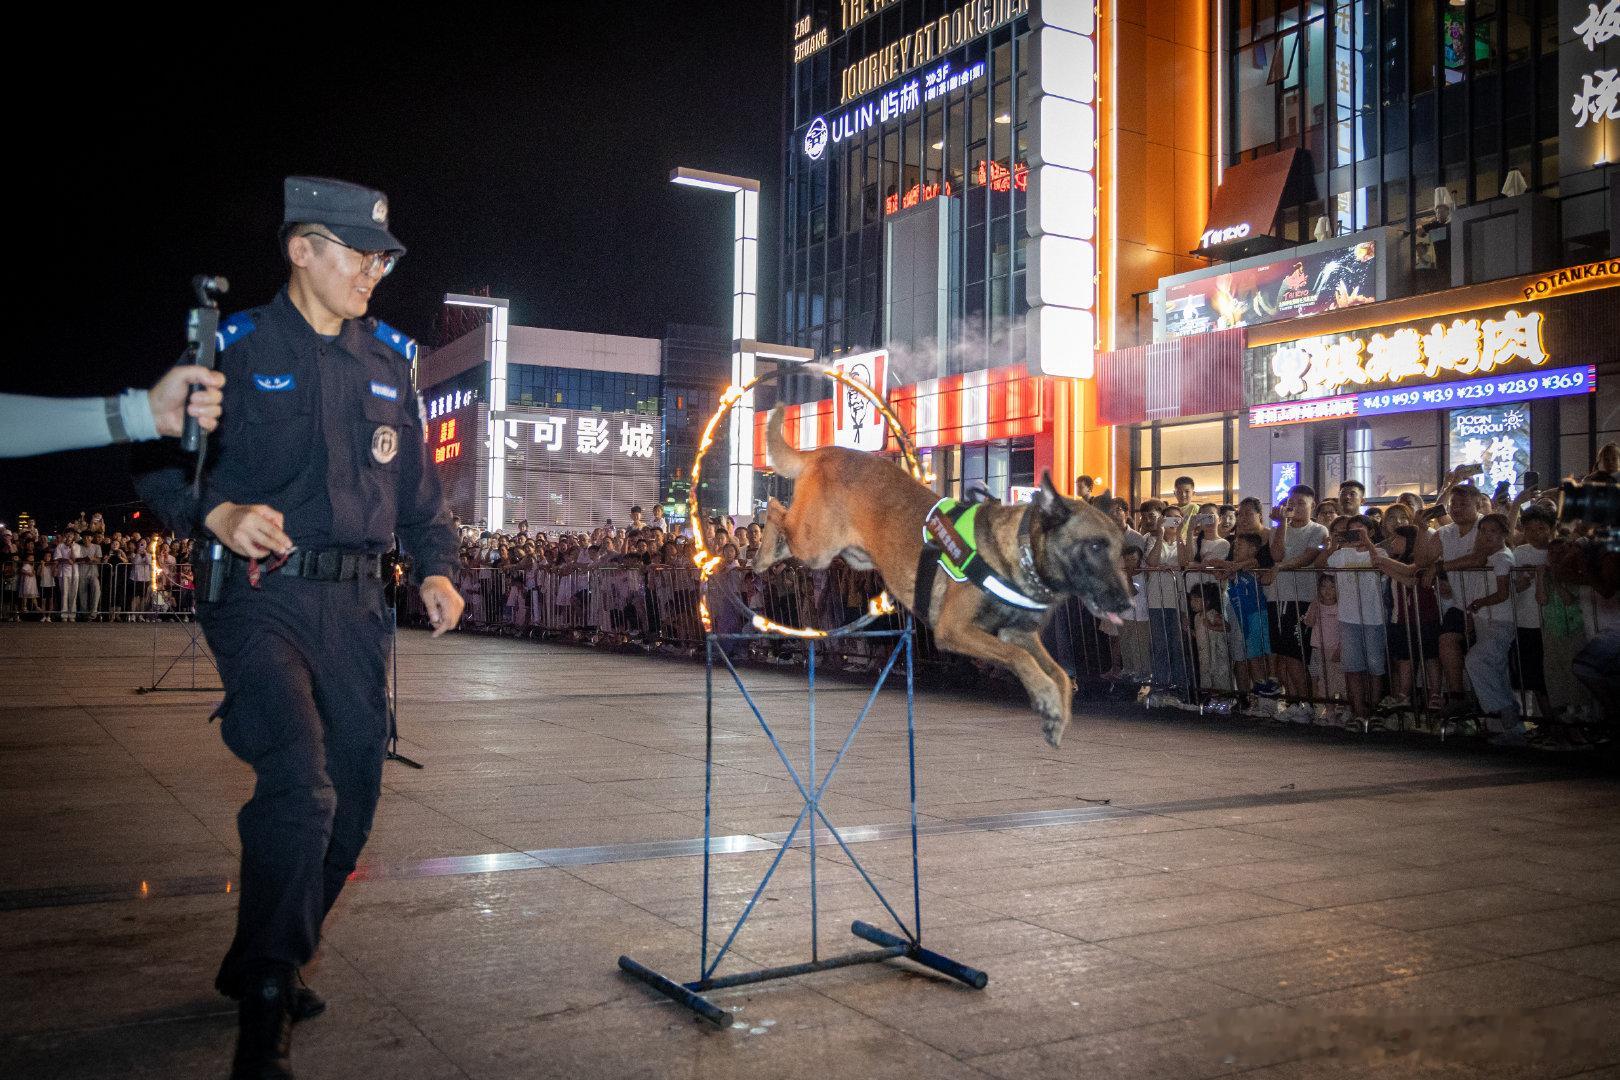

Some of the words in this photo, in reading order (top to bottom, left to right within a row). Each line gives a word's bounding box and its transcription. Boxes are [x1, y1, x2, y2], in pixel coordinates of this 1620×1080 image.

[840, 34, 909, 105] JOURNEY
[913, 21, 936, 67] AT
[1523, 261, 1620, 300] POTANKAO
[1392, 391, 1419, 406] ¥9.9
[1456, 383, 1494, 399] ¥23.9
[1498, 378, 1538, 394] ¥28.9
[1541, 372, 1584, 389] ¥36.9
